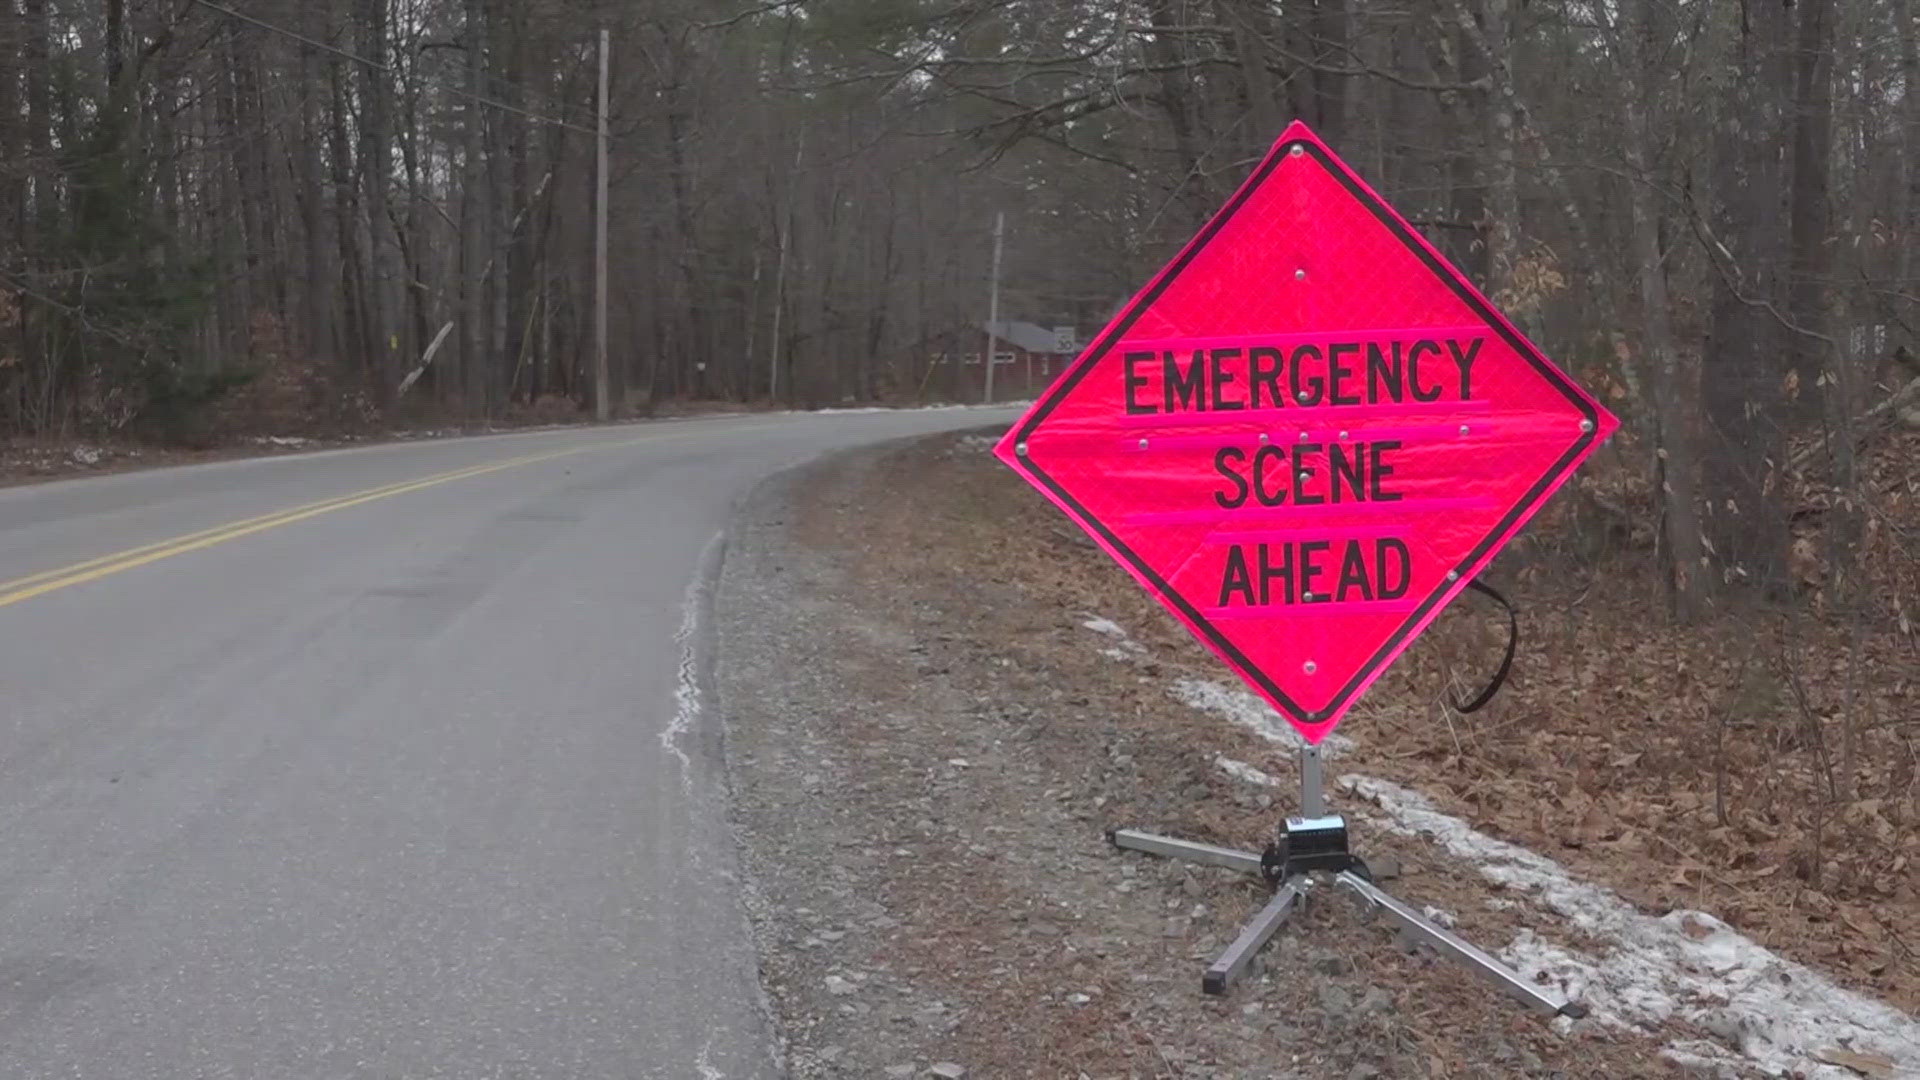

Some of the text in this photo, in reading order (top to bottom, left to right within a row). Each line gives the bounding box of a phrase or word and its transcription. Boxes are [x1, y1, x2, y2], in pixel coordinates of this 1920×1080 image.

[1057, 340, 1073, 351] 30
[1124, 338, 1484, 415] EMERGENCY
[1214, 440, 1403, 509] SCENE
[1219, 538, 1411, 607] AHEAD
